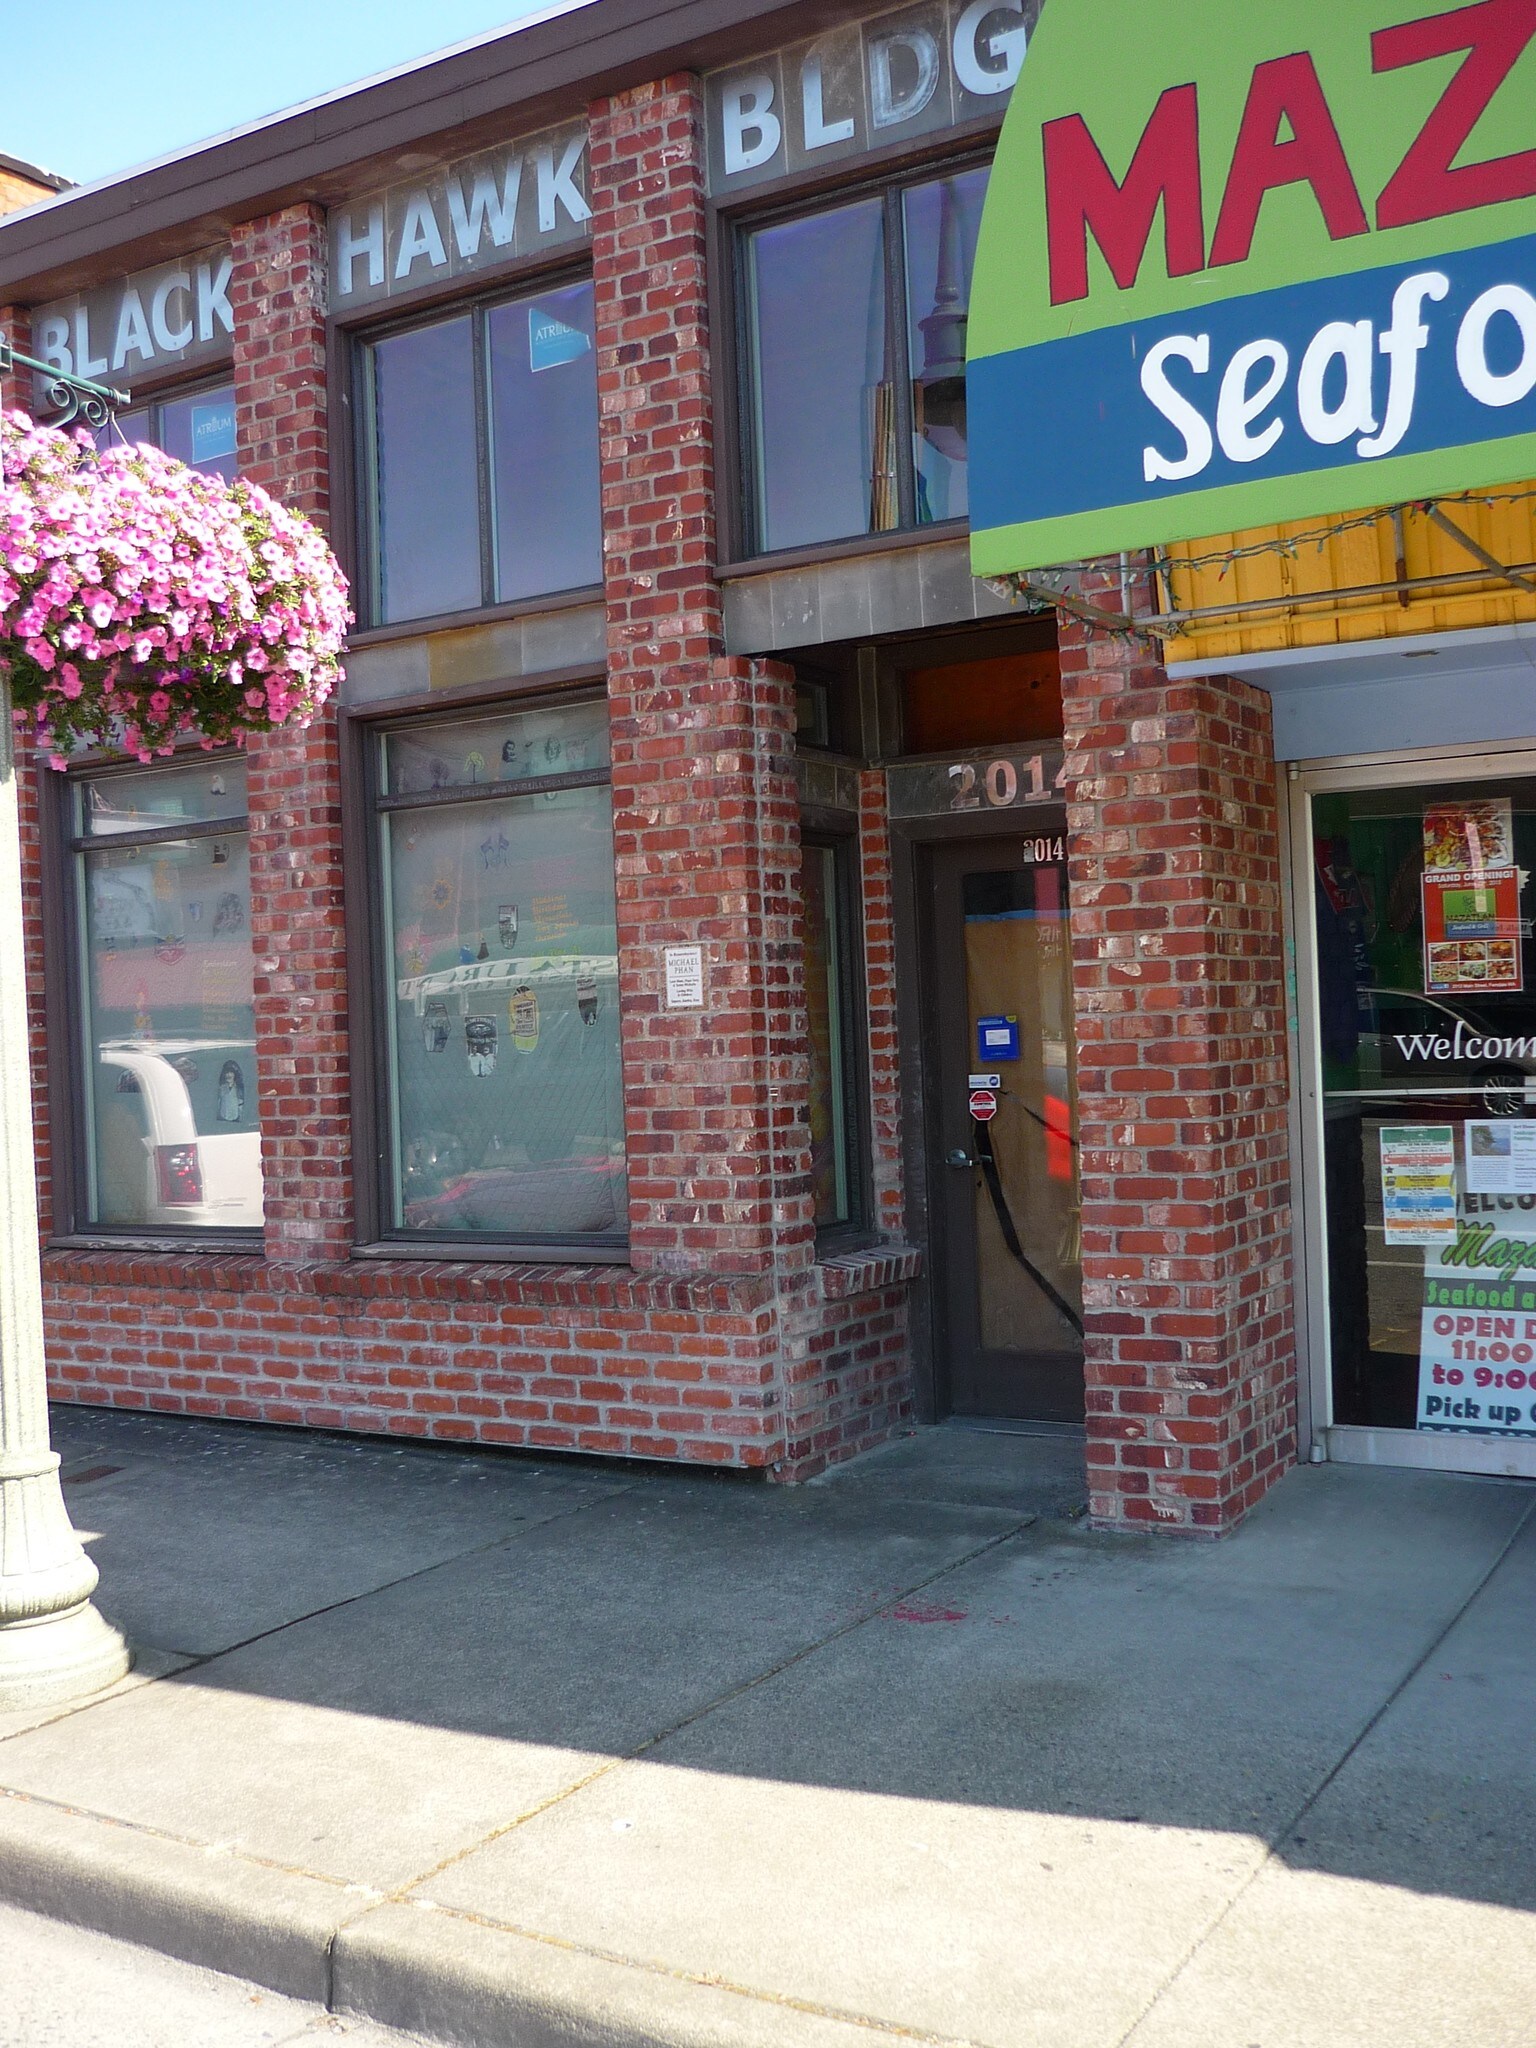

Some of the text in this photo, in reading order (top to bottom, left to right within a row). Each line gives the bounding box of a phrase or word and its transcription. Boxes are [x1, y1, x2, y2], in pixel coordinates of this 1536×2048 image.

[38, 0, 1027, 390] BLACK HAWK BLDG
[1425, 870, 1514, 883] GRAND OPENING!
[668, 958, 699, 967] MICHAEL
[674, 966, 694, 974] PHAN
[1456, 1192, 1536, 1214] ELCO
[1427, 1280, 1516, 1308] Seafood
[1433, 1314, 1515, 1339] OPEN
[1451, 1339, 1534, 1364] 11:00
[1432, 1363, 1464, 1386] to
[1425, 1395, 1481, 1419] Pick
[1488, 1405, 1522, 1426] up
